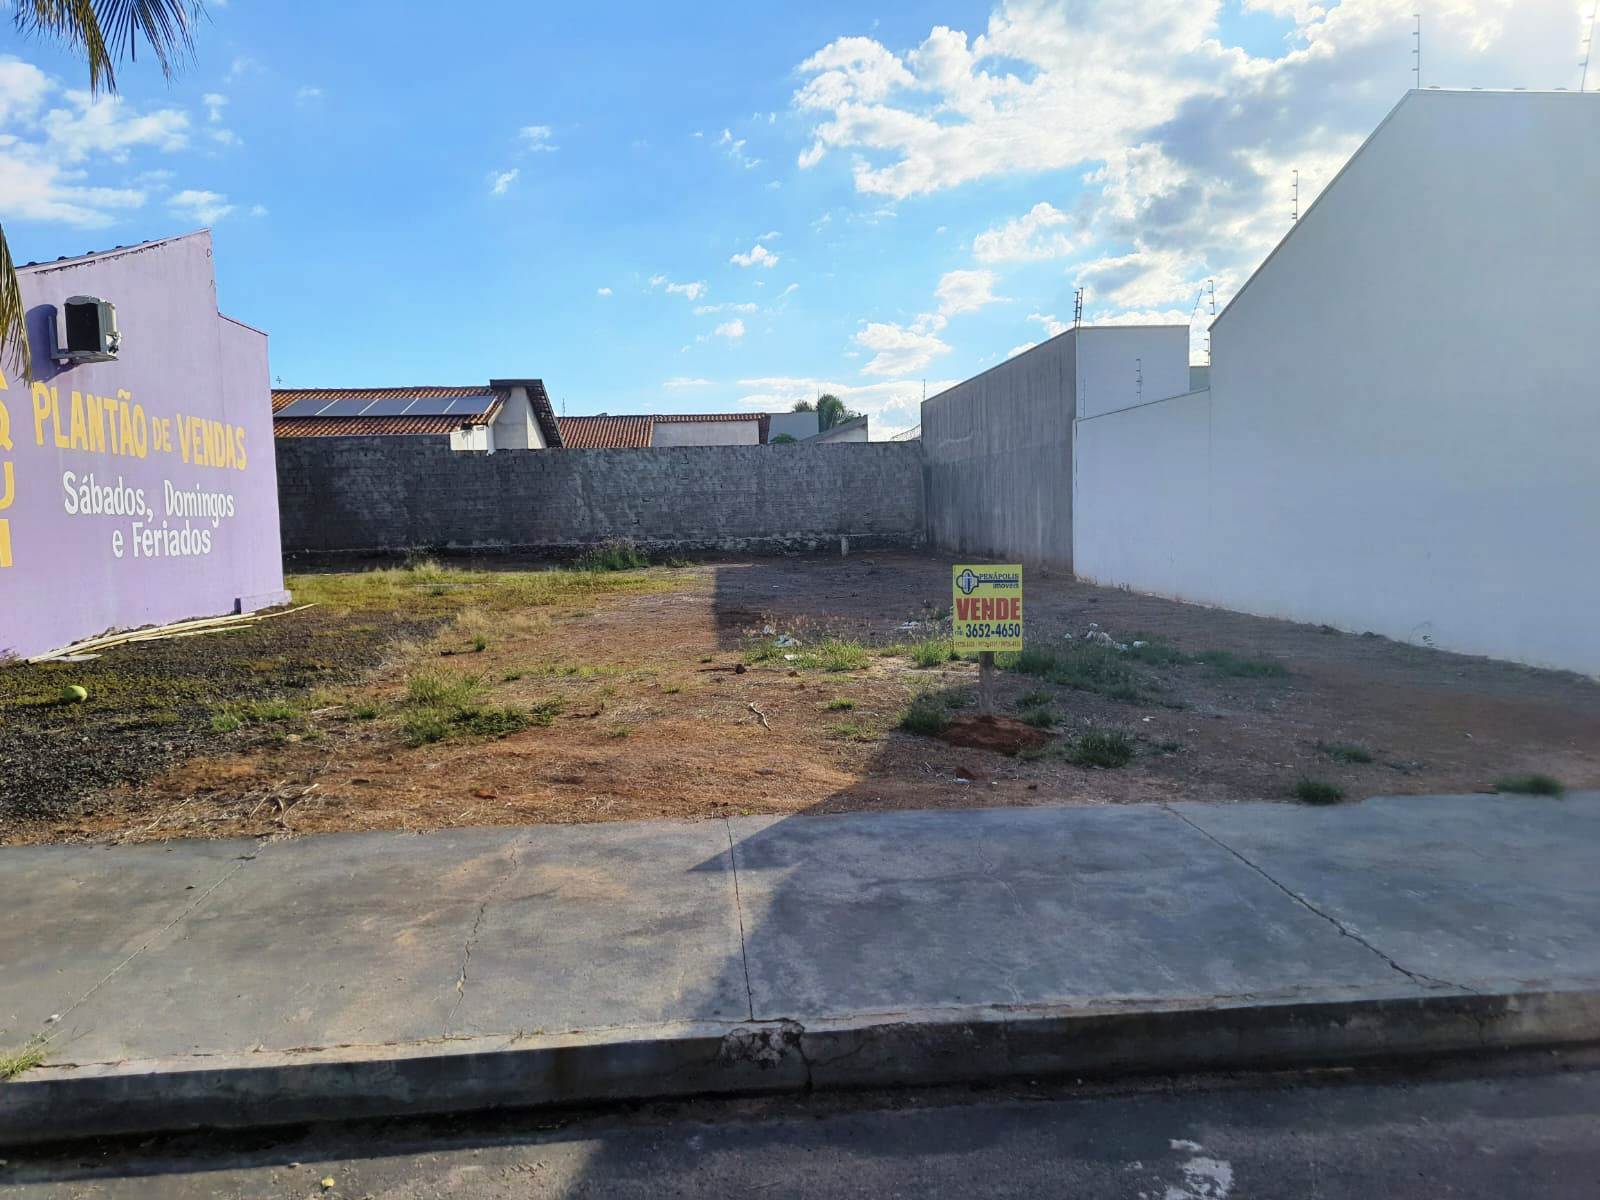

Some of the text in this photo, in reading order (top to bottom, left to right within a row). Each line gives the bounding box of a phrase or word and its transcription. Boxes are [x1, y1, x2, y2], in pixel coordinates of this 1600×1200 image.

[32, 380, 247, 470] PLANTÃO DE VENDAS
[63, 471, 235, 528] Sábados, Domingos
[112, 520, 212, 558] e Feriados
[956, 598, 1020, 621] VENDE
[966, 624, 1020, 638] 3652-4650
